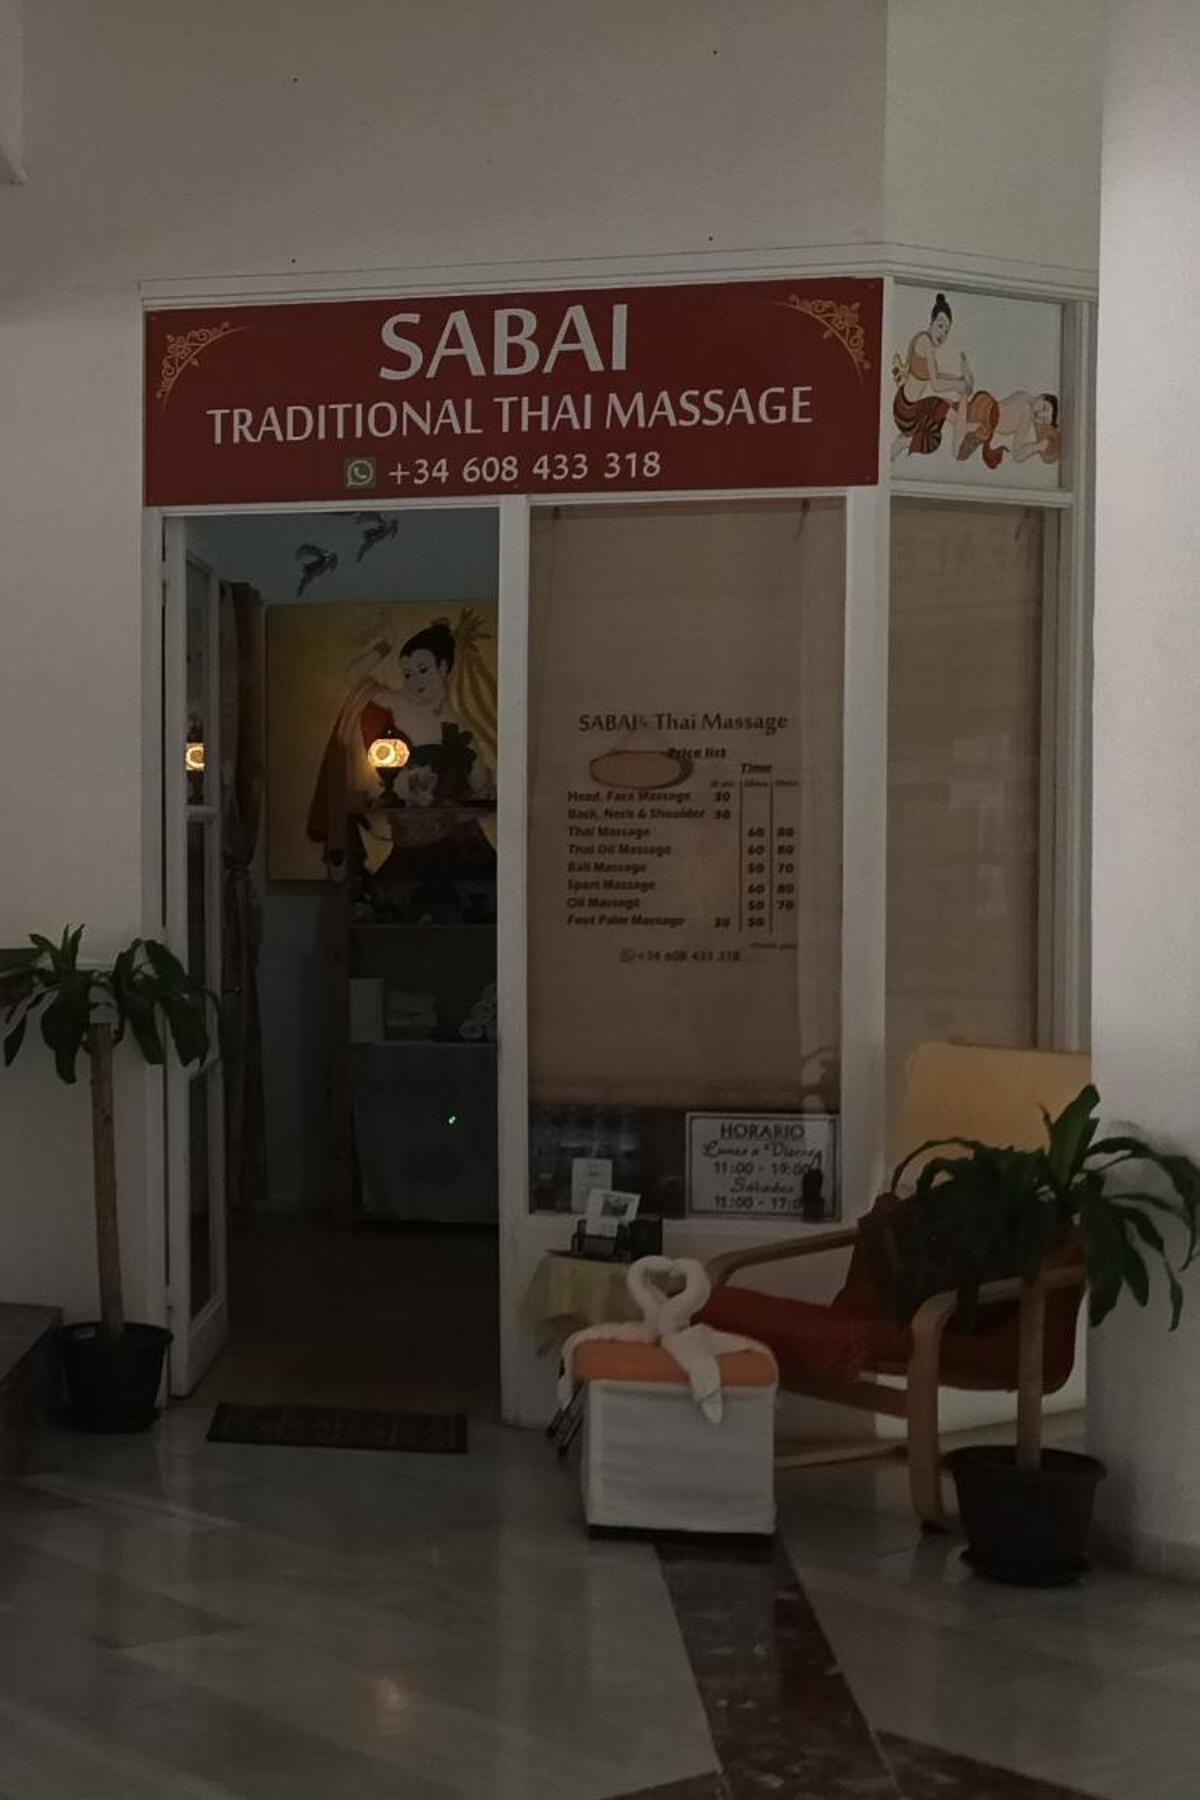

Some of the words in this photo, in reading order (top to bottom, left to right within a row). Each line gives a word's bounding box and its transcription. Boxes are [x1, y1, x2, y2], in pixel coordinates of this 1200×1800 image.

[379, 302, 628, 381] SABAI
[206, 399, 483, 445] TRADITIONAL
[493, 394, 592, 433] THAI
[605, 386, 813, 430] MASSAGE
[388, 457, 449, 486] +34
[462, 455, 520, 483] 608
[531, 453, 589, 481] 433
[603, 451, 662, 480] 318
[655, 713, 697, 731] Thai
[701, 713, 789, 738] Massage
[638, 791, 690, 803] Massage
[597, 827, 650, 840] Massage
[618, 844, 671, 857] Massage
[593, 861, 647, 875] Massage
[602, 880, 657, 892] Massage
[587, 897, 640, 911] Massage
[631, 914, 685, 928] Massage
[721, 1122, 805, 1140] HORARIO
